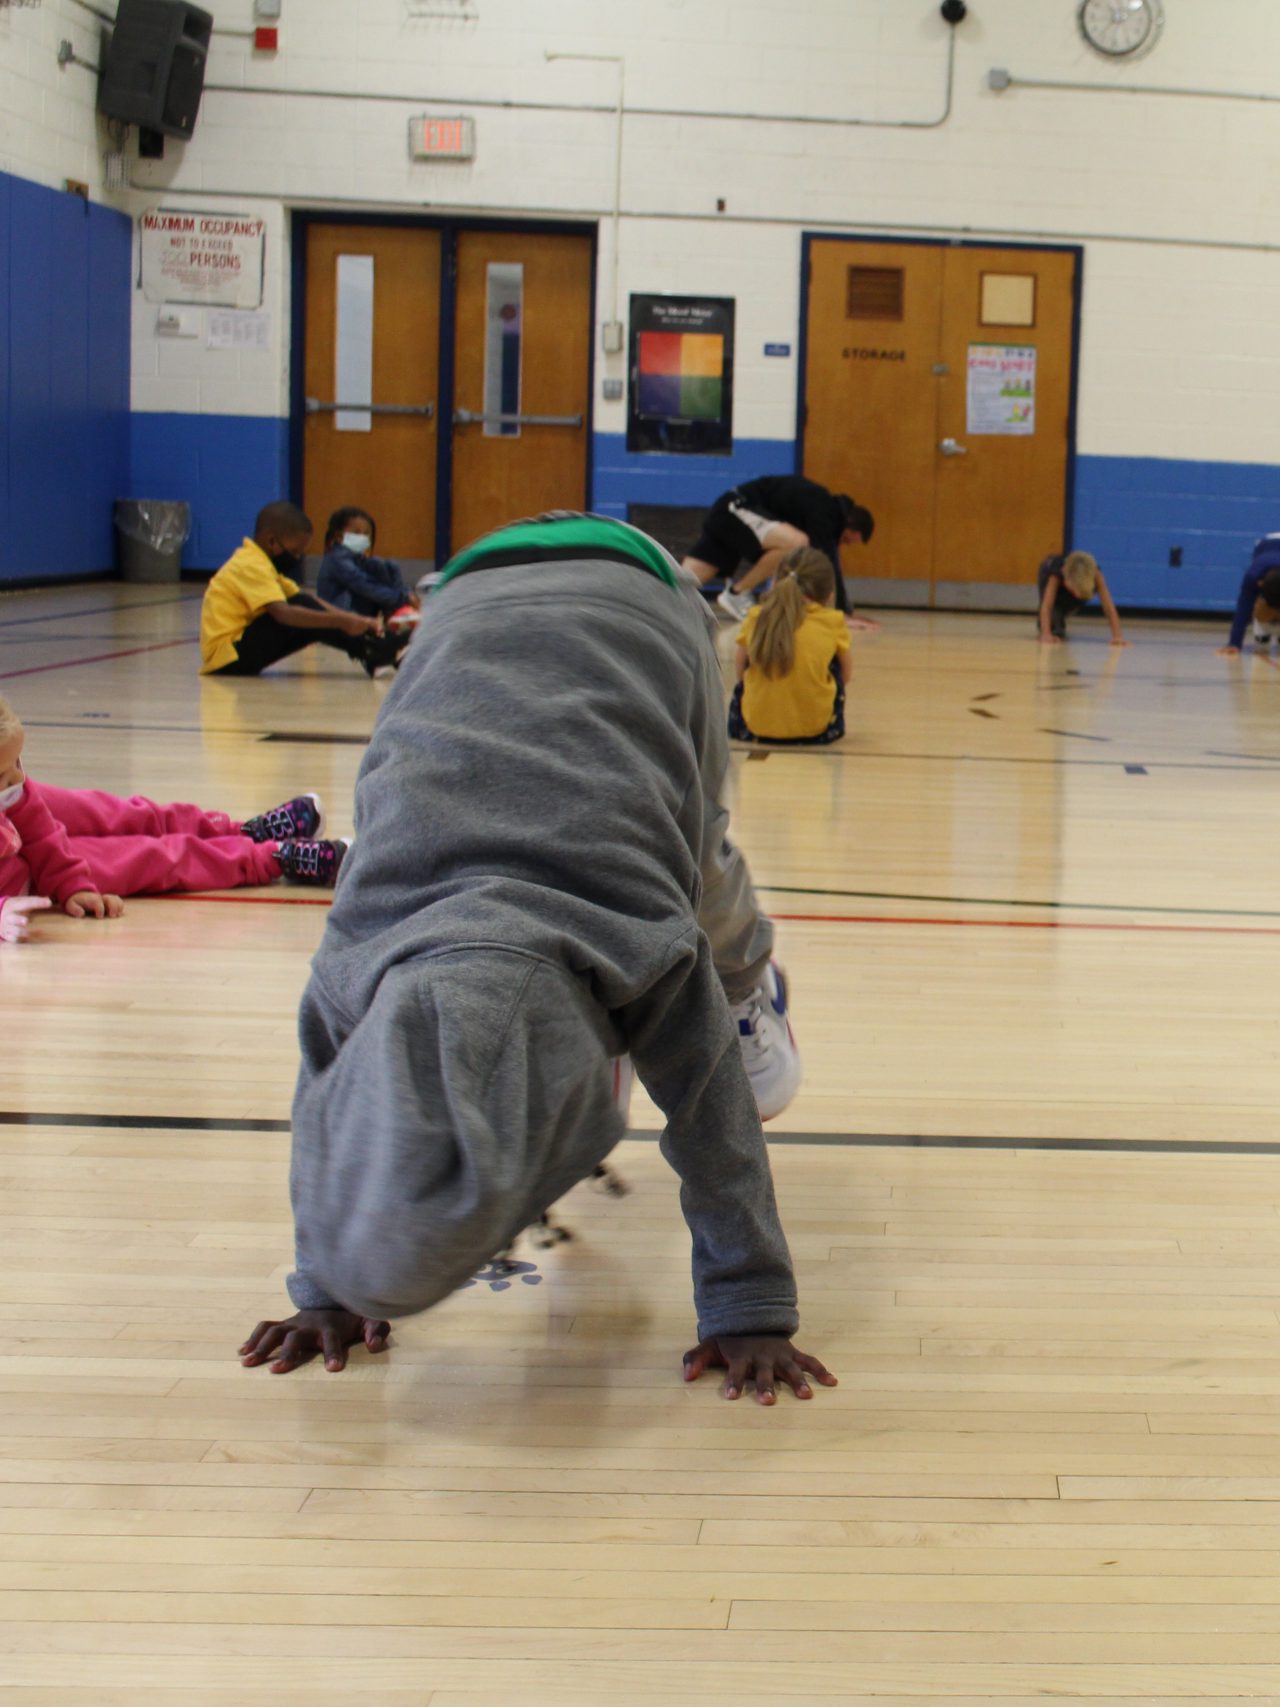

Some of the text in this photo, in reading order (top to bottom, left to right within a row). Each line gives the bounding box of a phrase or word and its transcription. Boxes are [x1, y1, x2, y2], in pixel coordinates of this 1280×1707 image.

[423, 119, 463, 152] EXIT
[143, 215, 264, 237] MAXIMUM OCCUPANCY
[169, 237, 186, 249] NOT
[190, 238, 199, 249] TO
[189, 252, 241, 270] PERSONS
[842, 347, 906, 361] STORAGE
